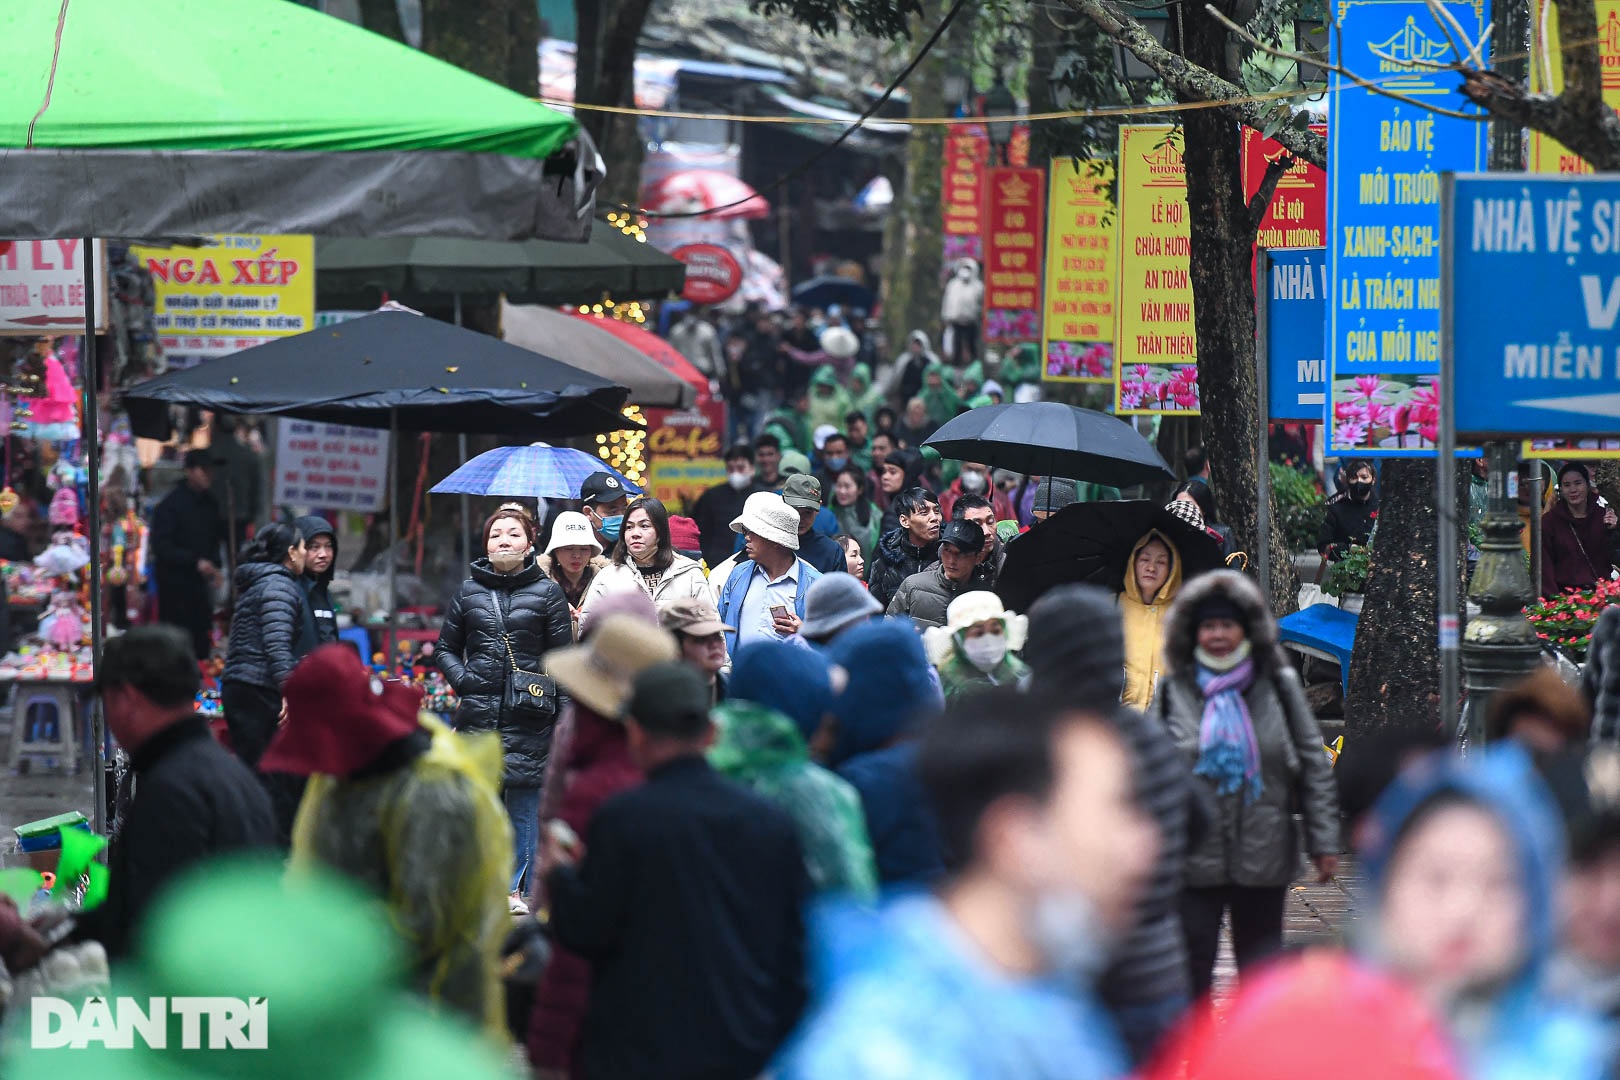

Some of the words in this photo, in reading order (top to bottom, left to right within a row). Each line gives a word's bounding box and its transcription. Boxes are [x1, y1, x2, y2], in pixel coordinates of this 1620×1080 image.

[1380, 107, 1411, 152] BẢO
[1415, 113, 1434, 159] VỆ
[1360, 166, 1389, 205] MÔI
[1393, 164, 1441, 205] TRƯỜN
[1152, 196, 1163, 223] LỄ
[1166, 200, 1183, 228] HỘI
[1272, 196, 1285, 220] LỄ
[1287, 198, 1304, 223] HỘI
[1472, 187, 1536, 253] NHÀ
[1545, 187, 1582, 266] VỆ
[1591, 199, 1620, 254] SI
[1135, 232, 1161, 256] CHÙA
[1164, 235, 1191, 256] HƯƠN
[1256, 226, 1284, 247] CHÙA
[1286, 228, 1320, 247] HƯƠNG
[146, 258, 222, 284] NGA
[231, 248, 299, 285] XẾP
[1145, 270, 1159, 289] AN
[1162, 266, 1187, 289] TOÀN
[1273, 257, 1315, 300] NHÀ
[1342, 272, 1361, 310] LÀ
[1365, 272, 1414, 310] TRÁCH
[1141, 298, 1160, 322] VĂN
[1164, 303, 1190, 322] MINH
[1136, 331, 1162, 355] THÂN
[1165, 331, 1193, 359] THIỆN
[1347, 317, 1378, 362] CỦA
[1381, 318, 1412, 362] MỖI
[1504, 331, 1602, 379] MIỄN
